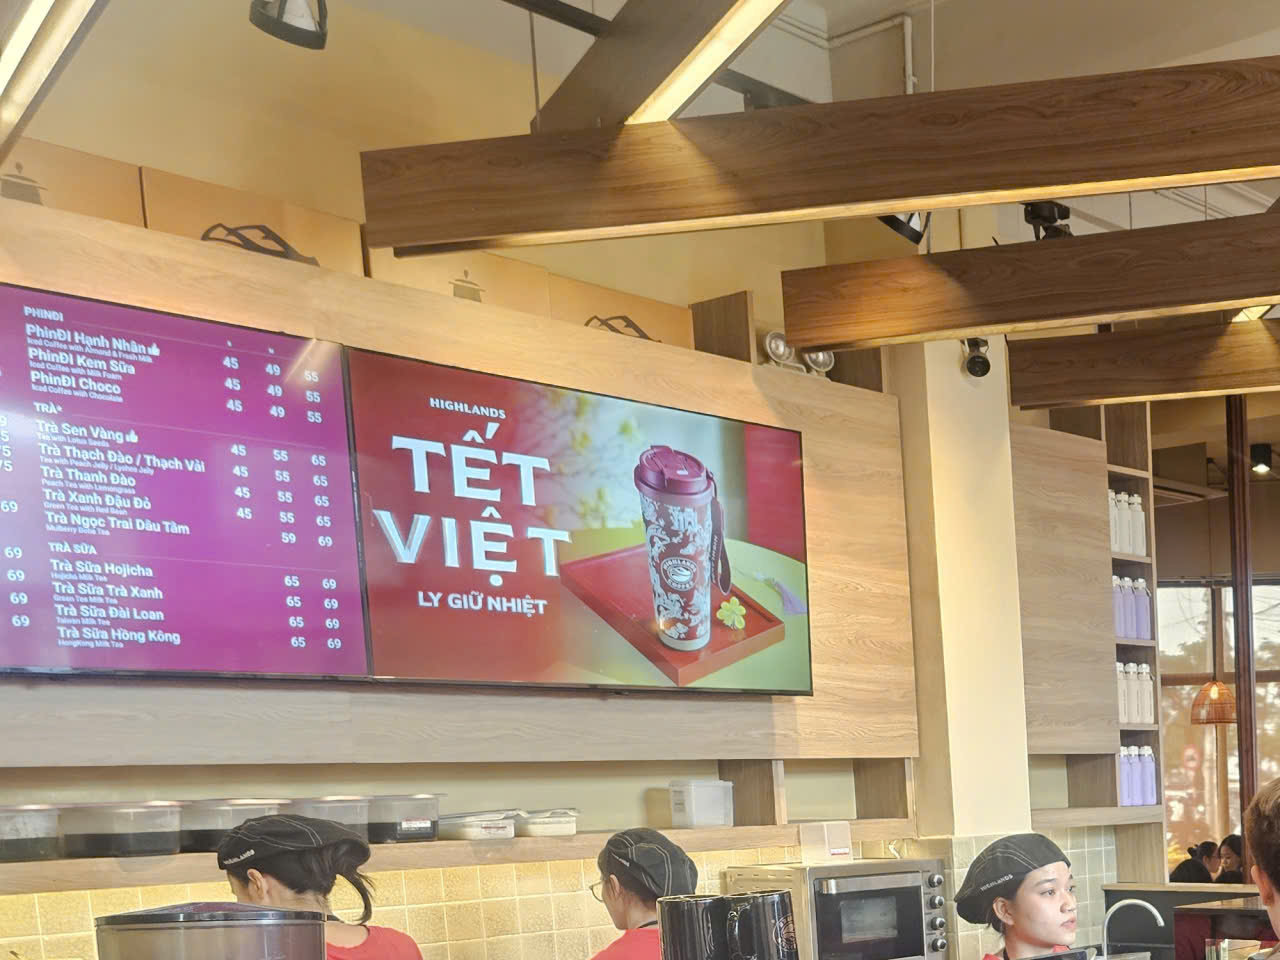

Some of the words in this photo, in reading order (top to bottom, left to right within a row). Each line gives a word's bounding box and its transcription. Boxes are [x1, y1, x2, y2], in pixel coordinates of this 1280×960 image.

[74, 332, 109, 349] Hạnh
[112, 337, 146, 354] Nhân
[76, 355, 106, 370] Kem
[110, 359, 135, 375] Sữa
[223, 356, 240, 370] 45
[265, 364, 281, 376] 49
[304, 370, 320, 382] 55
[79, 378, 121, 394] Choco
[224, 377, 241, 391] 45
[267, 384, 283, 397] 49
[305, 390, 321, 403] 55
[226, 399, 243, 412] 45
[270, 405, 286, 418] 49
[430, 397, 506, 420] HIGHLANDS
[307, 410, 322, 424] 55
[37, 419, 59, 434] Trà
[62, 422, 88, 437] Sen
[90, 425, 124, 443] Vàng
[230, 443, 247, 456] 45
[273, 449, 289, 462] 55
[38, 442, 61, 456] Trà
[64, 445, 104, 462] Thạch
[107, 449, 133, 464] Đào
[144, 454, 182, 471] Thạch
[311, 454, 326, 467] 65
[232, 465, 249, 478] 45
[391, 422, 550, 508] TẾT
[40, 465, 63, 479] Trà
[66, 468, 107, 484] Thanh
[110, 471, 136, 486] Đào
[275, 470, 291, 482] 55
[313, 475, 328, 487] 65
[42, 488, 66, 502] Trà
[68, 491, 102, 505] Xanh
[105, 493, 130, 509] Đậu
[234, 486, 250, 499] 45
[277, 490, 293, 503] 55
[0, 500, 18, 513] 69
[314, 495, 330, 507] 65
[236, 507, 252, 520] 45
[279, 511, 295, 524] 55
[45, 510, 67, 525] Trà
[70, 513, 105, 529] Ngọc
[108, 516, 133, 530] Trai
[136, 518, 160, 533] Dâu
[316, 515, 331, 527] 65
[281, 532, 296, 544] 59
[318, 535, 333, 547] 69
[4, 546, 23, 559] 69
[48, 542, 72, 553] TRÀ
[372, 506, 573, 588] VIỆT
[50, 559, 73, 573] Trà
[75, 559, 102, 574] Sữa
[104, 562, 153, 578] Hojicha
[7, 570, 25, 582] 69
[284, 575, 300, 587] 65
[52, 581, 75, 595] Trà
[78, 582, 104, 596] Sữa
[105, 584, 128, 597] Trà
[131, 586, 163, 600] Xanh
[322, 578, 337, 590] 69
[10, 592, 28, 605] 69
[286, 596, 302, 608] 65
[324, 598, 338, 609] 69
[417, 591, 442, 608] LY
[447, 591, 485, 611] GIỮ
[487, 591, 548, 618] NHIỆT
[54, 604, 77, 617] Trà
[80, 604, 106, 618] Sữa
[108, 606, 131, 620] Đài
[133, 608, 165, 621] Loan
[11, 615, 30, 628] 69
[289, 616, 305, 628] 65
[325, 618, 340, 629] 69
[56, 626, 80, 640] Trà
[82, 626, 109, 641] Sữa
[111, 628, 146, 644] Hồng
[148, 629, 181, 645] Kông
[291, 636, 306, 648] 65
[327, 638, 342, 649] 69
